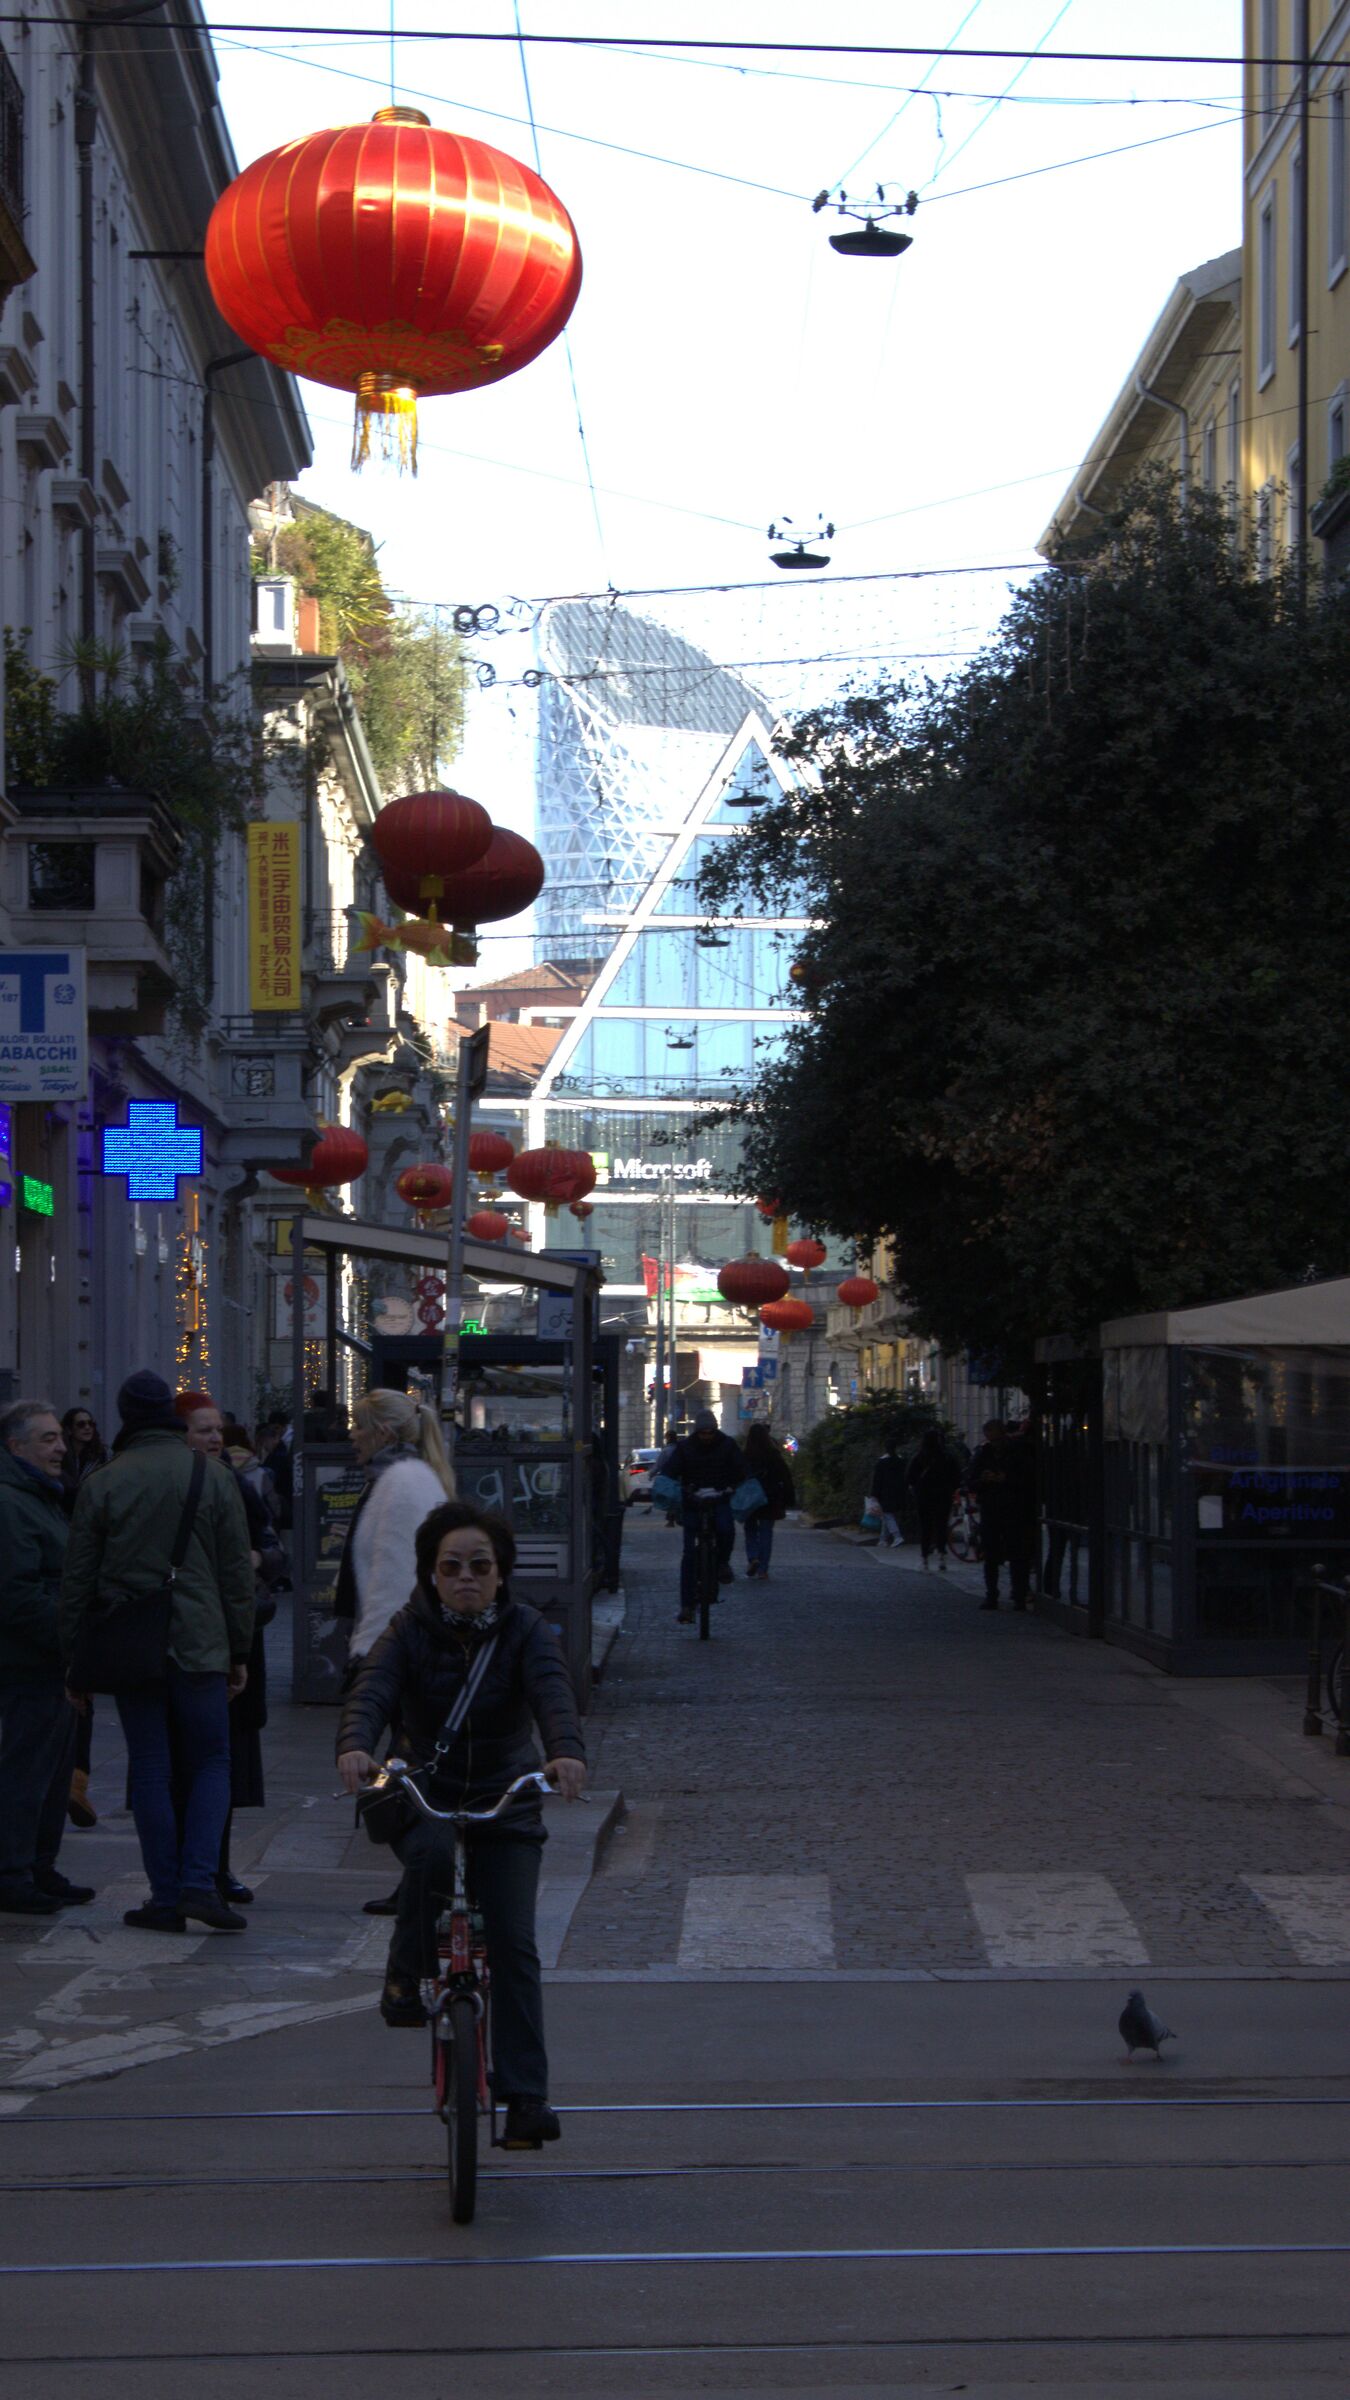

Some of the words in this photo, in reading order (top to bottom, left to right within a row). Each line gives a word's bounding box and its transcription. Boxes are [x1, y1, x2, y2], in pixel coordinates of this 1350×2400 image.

[272, 831, 292, 997] 米兰宇宙贸易公司
[0, 954, 69, 1033] T
[33, 1035, 75, 1043] BOLLATI
[40, 1079, 79, 1094] Totogol
[614, 1158, 713, 1180] Microsoft
[1229, 1471, 1341, 1494] Artigianale
[1241, 1503, 1336, 1525] Aperitivo
